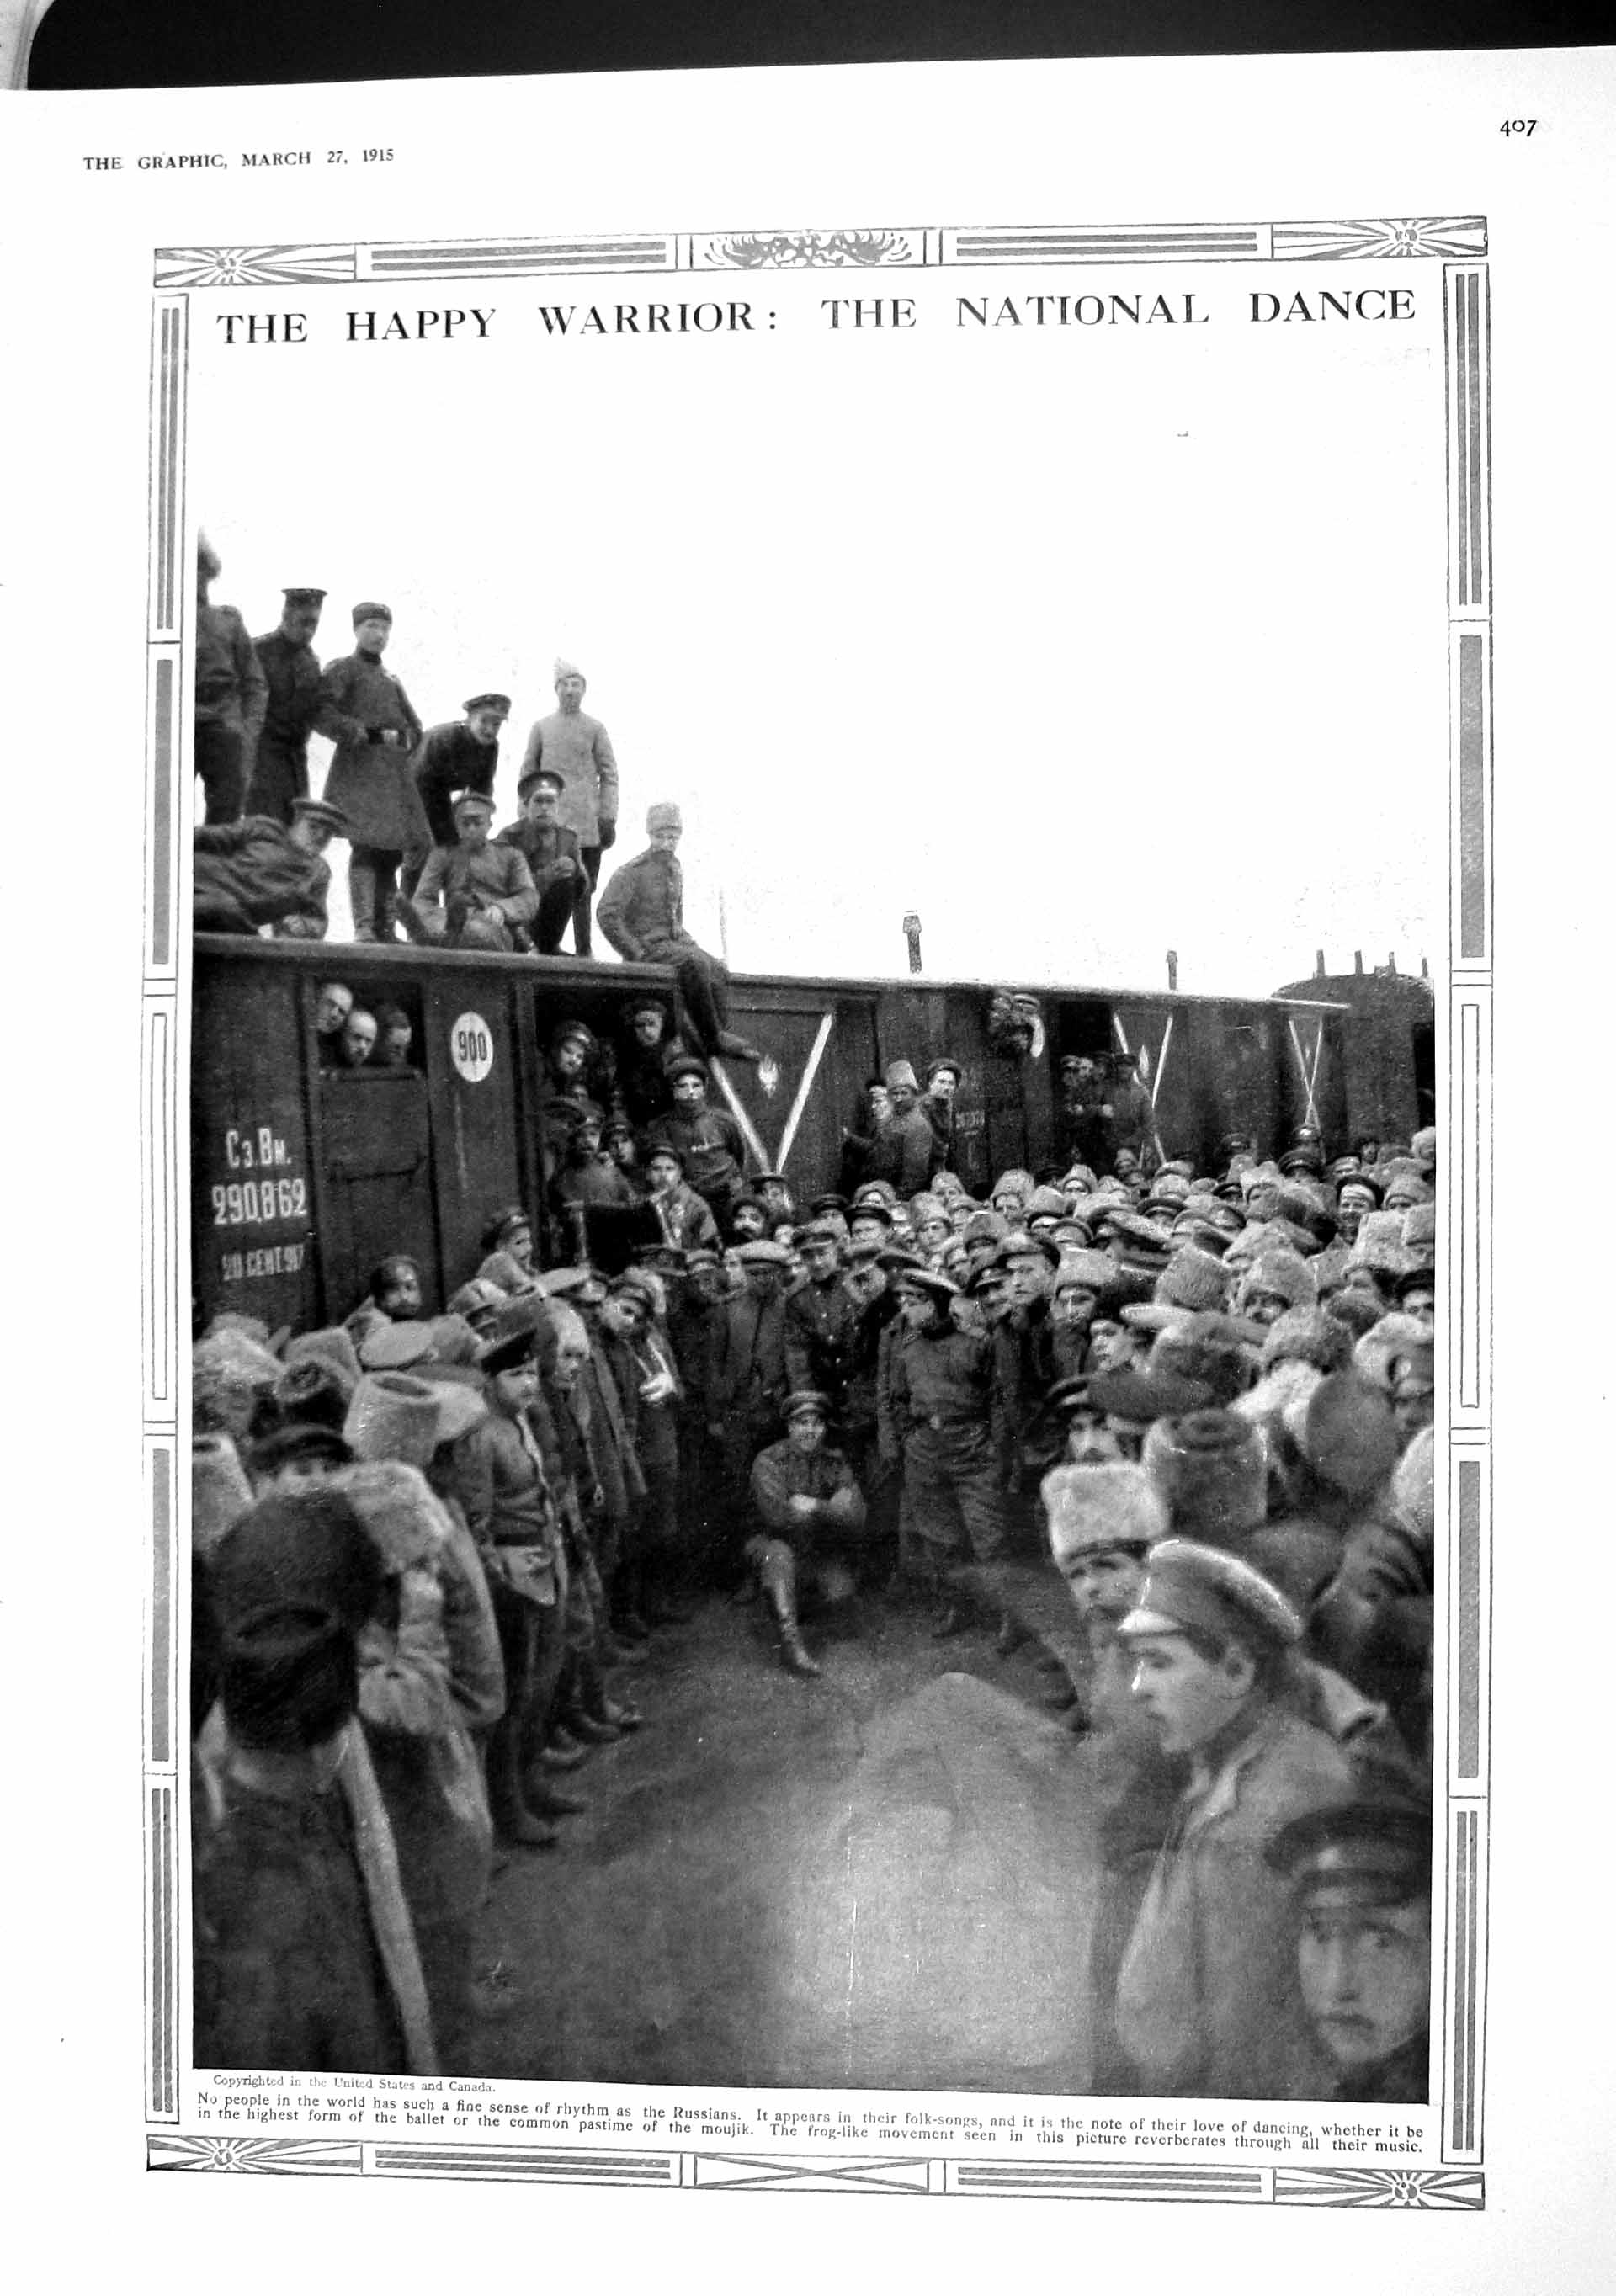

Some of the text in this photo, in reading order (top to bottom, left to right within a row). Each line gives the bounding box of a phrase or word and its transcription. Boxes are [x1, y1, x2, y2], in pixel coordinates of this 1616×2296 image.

[1499, 120, 1538, 137] 407
[83, 148, 394, 171] THE GRAPHIC, MARCH 27, 1915
[216, 315, 308, 344] THE
[346, 308, 497, 342] HAPPY
[821, 299, 917, 329] THE
[957, 294, 1209, 327] NATIONAL
[1249, 290, 1417, 323] DANCE
[459, 1031, 487, 1062] 900
[212, 2074, 497, 2092] Copyrighted in the United States and Canada.
[198, 2092, 1423, 2139] No people in the world has such a fine sense of rhythm as the Russians. It appears in their folk-songs, and it is the note of their love of dancing, whether it be
[198, 2107, 1423, 2152] in the highest form of the ballet or the common pastime of the moujik. The frog-like movement seen in this picture reverberates through all their music.
